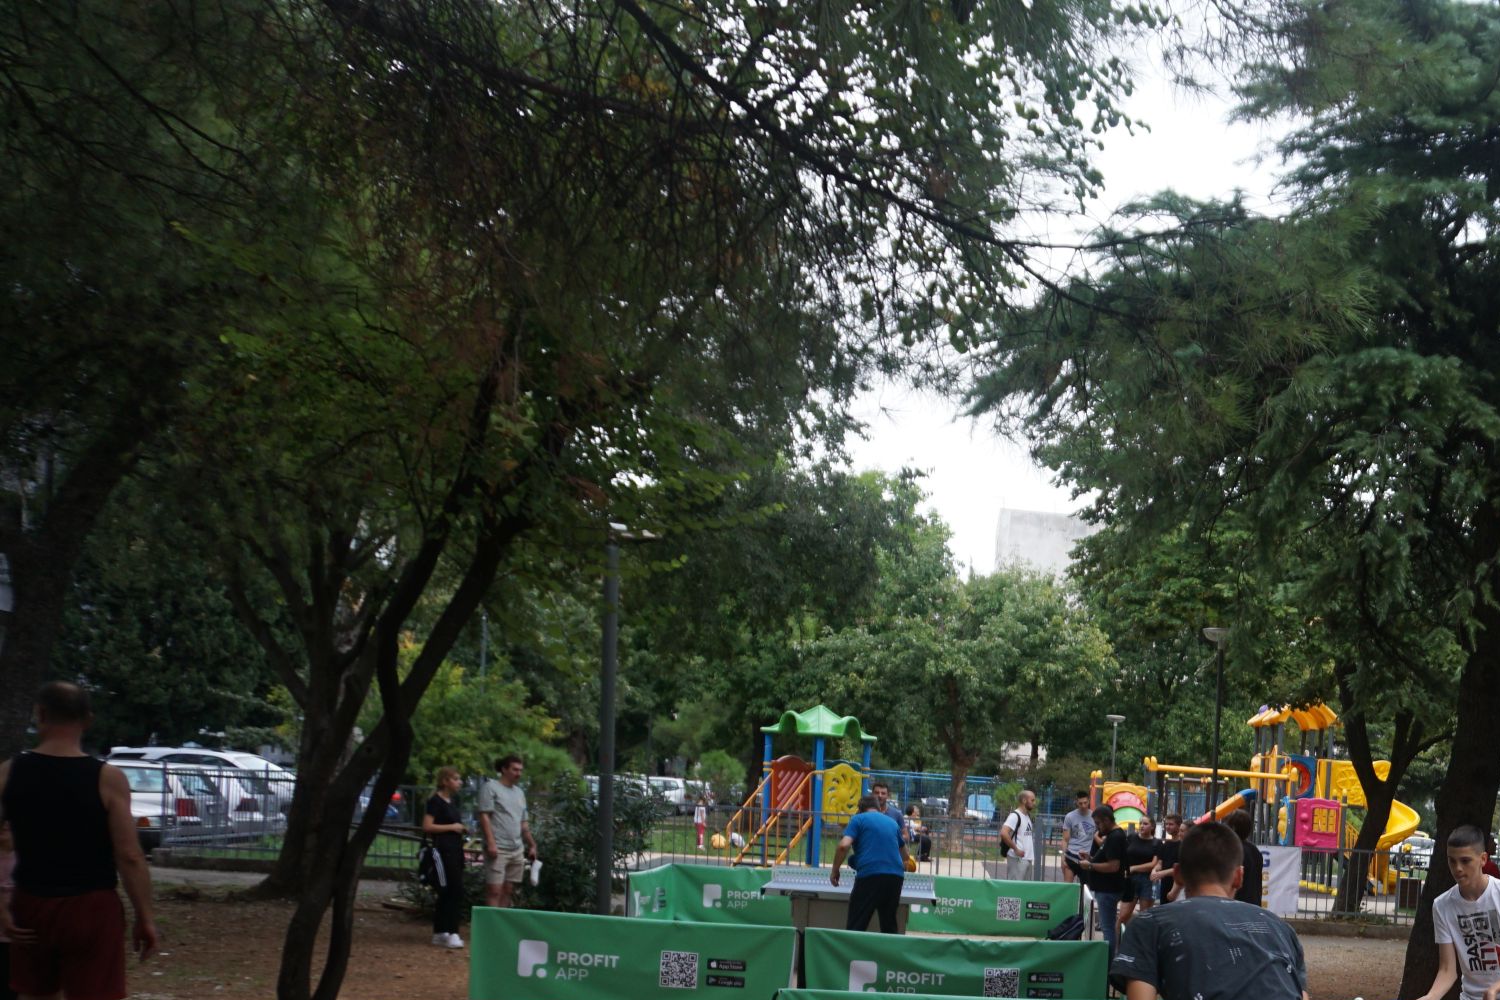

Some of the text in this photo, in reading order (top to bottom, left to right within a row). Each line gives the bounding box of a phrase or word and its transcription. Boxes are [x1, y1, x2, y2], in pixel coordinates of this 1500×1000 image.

[556, 951, 620, 969] PROFIT
[554, 968, 589, 982] APP
[886, 970, 945, 986] PROFIT
